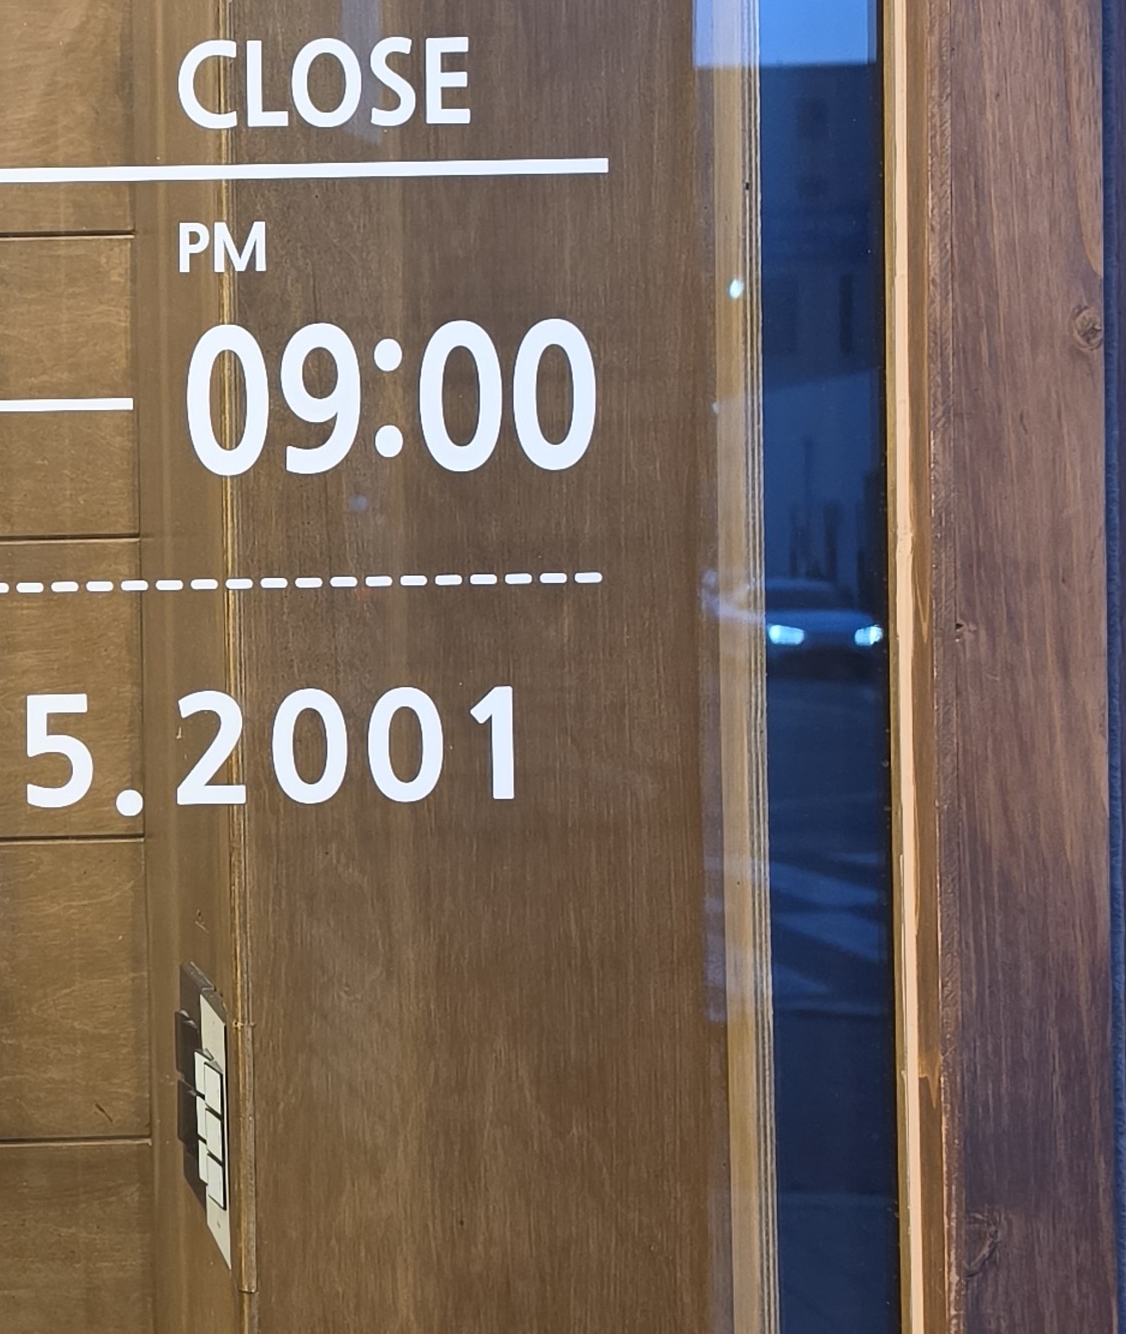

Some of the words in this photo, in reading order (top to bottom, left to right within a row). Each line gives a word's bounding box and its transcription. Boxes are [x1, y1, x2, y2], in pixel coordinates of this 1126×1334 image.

[178, 37, 471, 129] CLOSE
[179, 222, 267, 272] PM
[186, 319, 597, 476] 09:00
